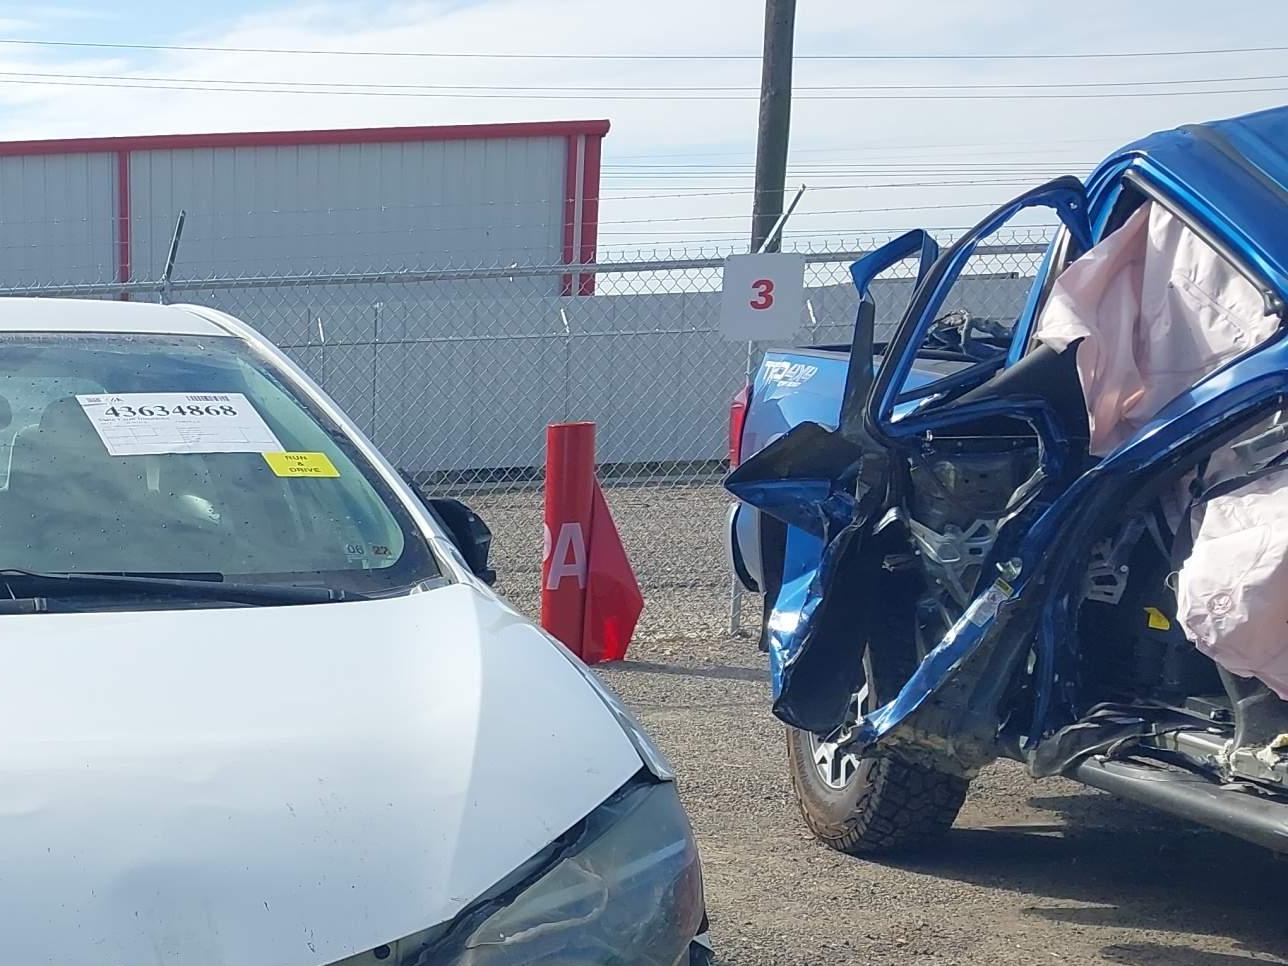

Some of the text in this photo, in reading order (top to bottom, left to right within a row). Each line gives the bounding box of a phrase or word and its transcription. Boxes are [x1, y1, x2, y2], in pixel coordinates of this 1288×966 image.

[750, 279, 774, 310] 3
[105, 404, 238, 418] 43634868
[543, 522, 587, 590] A
